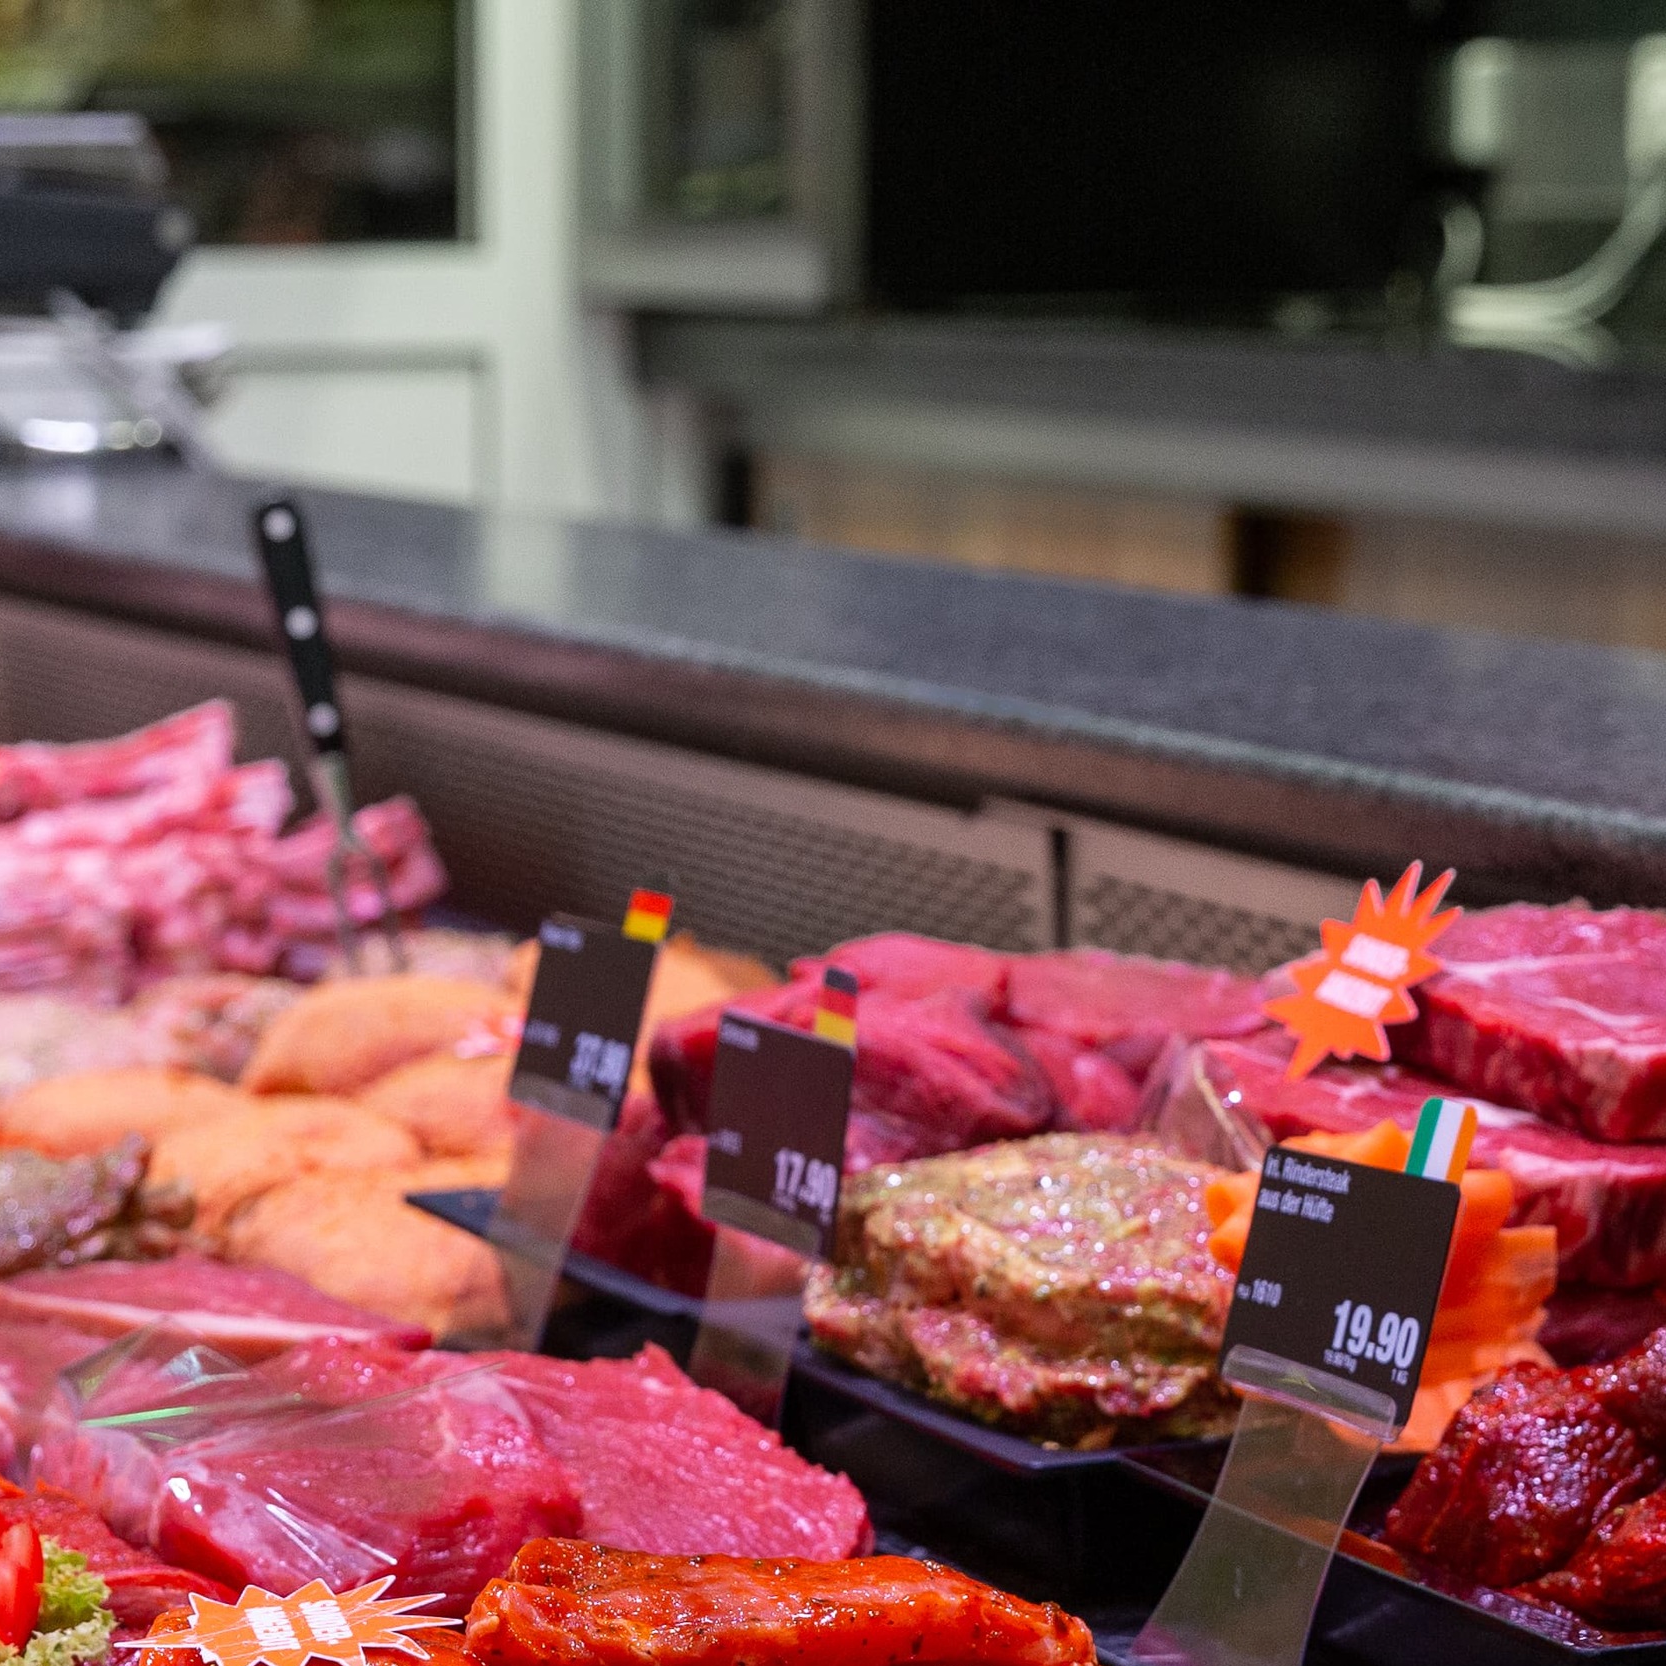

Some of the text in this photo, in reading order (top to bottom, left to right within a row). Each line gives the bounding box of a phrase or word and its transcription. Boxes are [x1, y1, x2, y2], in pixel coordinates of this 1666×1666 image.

[774, 1147, 838, 1208] 17.90
[1282, 1156, 1351, 1195] Rindersteak
[1257, 1188, 1334, 1224] aus der Hüfte
[1332, 1299, 1420, 1369] 19.90
[244, 1606, 301, 1651] ANGEBOT
[299, 1600, 354, 1645] SONDER-
